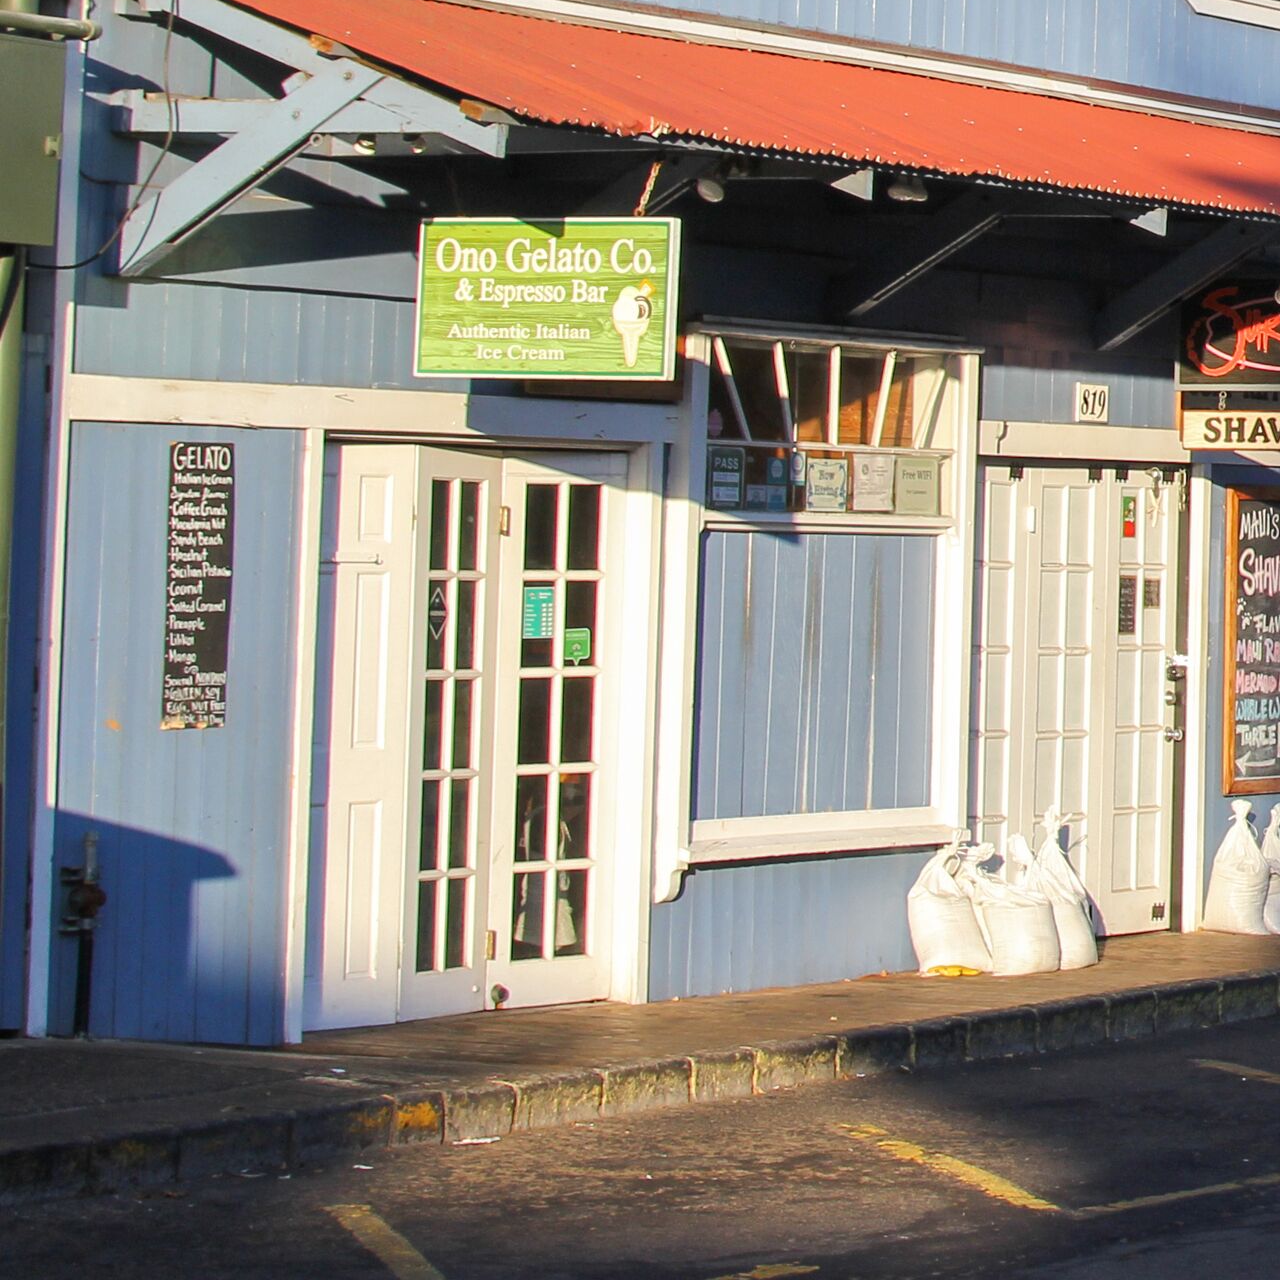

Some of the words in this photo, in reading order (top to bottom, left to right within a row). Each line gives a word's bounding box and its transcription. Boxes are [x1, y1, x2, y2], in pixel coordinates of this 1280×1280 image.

[436, 237, 497, 273] Ono
[505, 237, 601, 274] Gelato
[610, 238, 657, 274] Co.
[454, 278, 474, 301] &
[479, 278, 566, 308] Espresso
[571, 279, 608, 303] Bar
[447, 323, 530, 339] Authentic
[535, 324, 590, 340] Italian
[475, 344, 502, 360] Ice
[507, 345, 565, 360] Cream
[1081, 388, 1106, 419] 819
[173, 443, 231, 471] GELATO
[714, 457, 739, 469] PASS
[902, 470, 916, 480] Free
[1240, 507, 1280, 540] MAUI'S
[1236, 636, 1262, 664] MAUI
